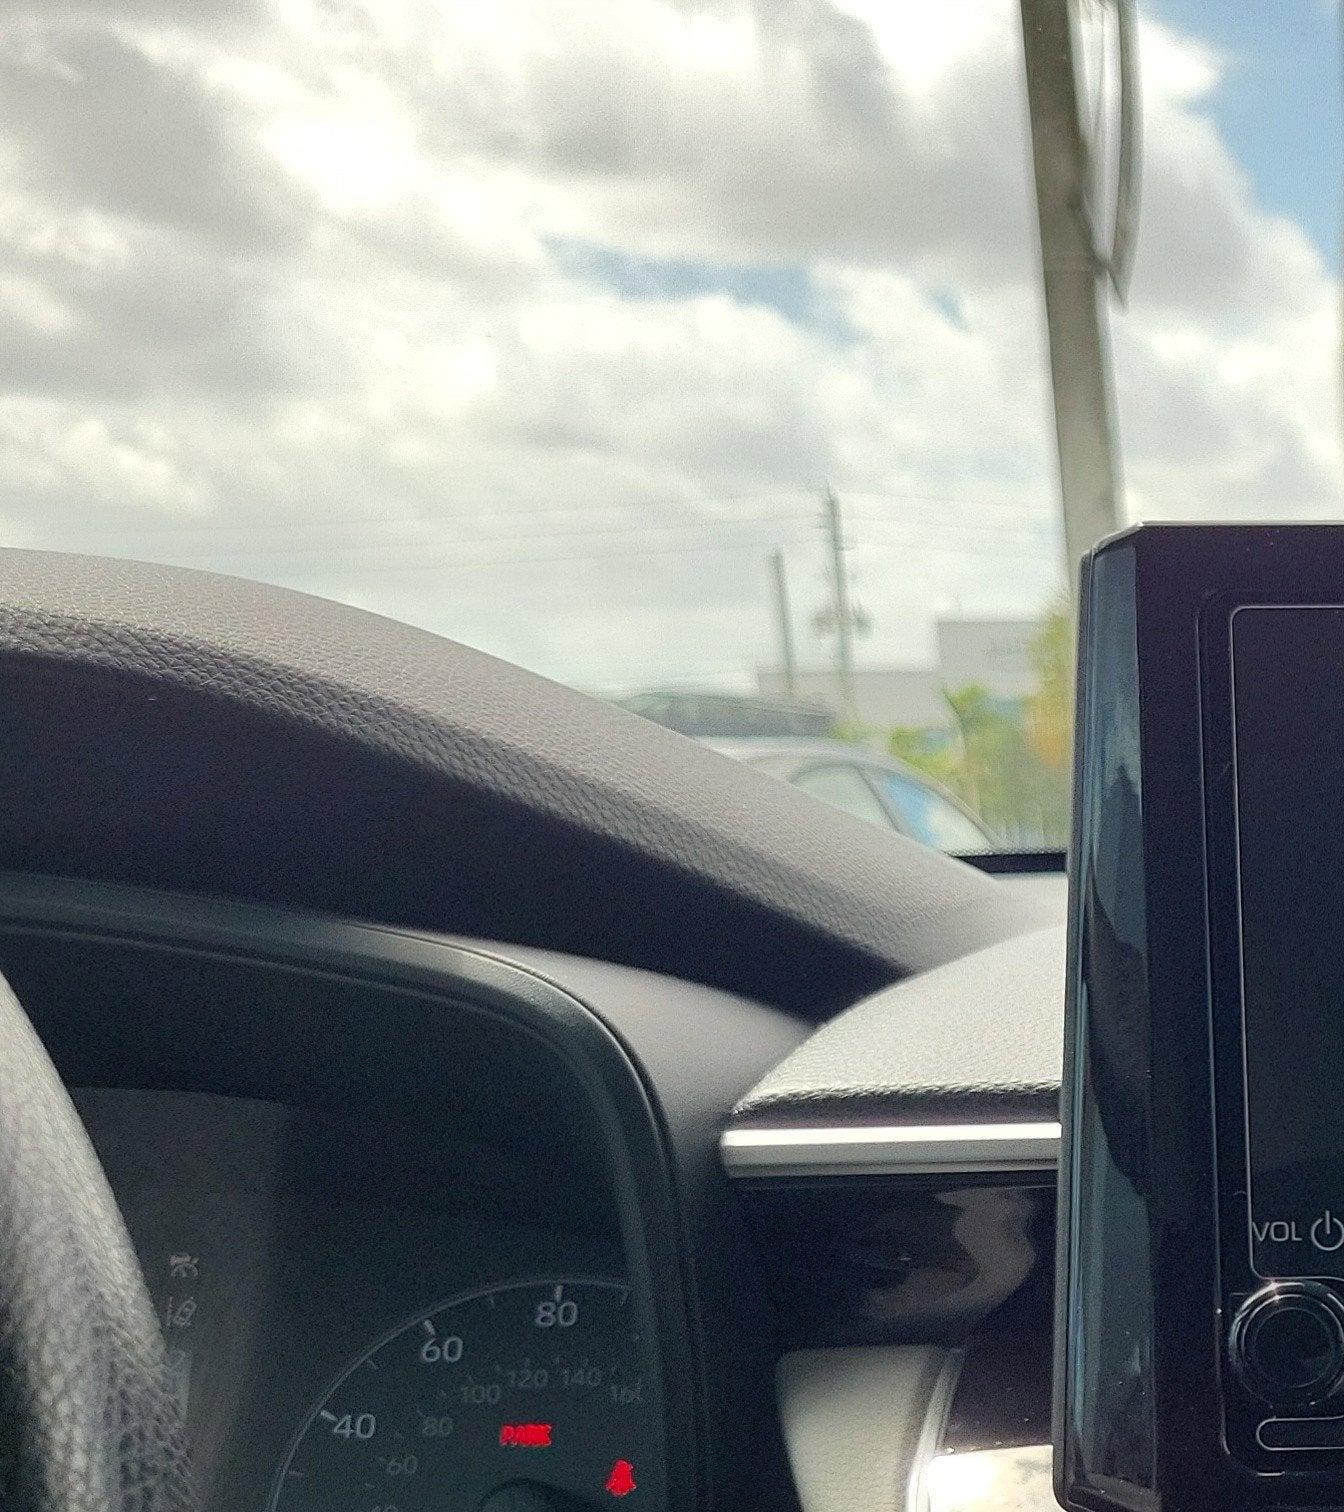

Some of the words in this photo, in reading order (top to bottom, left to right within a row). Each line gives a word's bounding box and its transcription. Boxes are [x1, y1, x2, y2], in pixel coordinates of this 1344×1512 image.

[1252, 1221, 1303, 1242] VOL
[534, 1300, 579, 1329] 80
[419, 1336, 464, 1363] 60
[507, 1368, 549, 1390] 120
[460, 1383, 501, 1405] 100
[331, 1412, 377, 1441] 40
[421, 1415, 454, 1438] 80
[385, 1454, 419, 1476] 60
